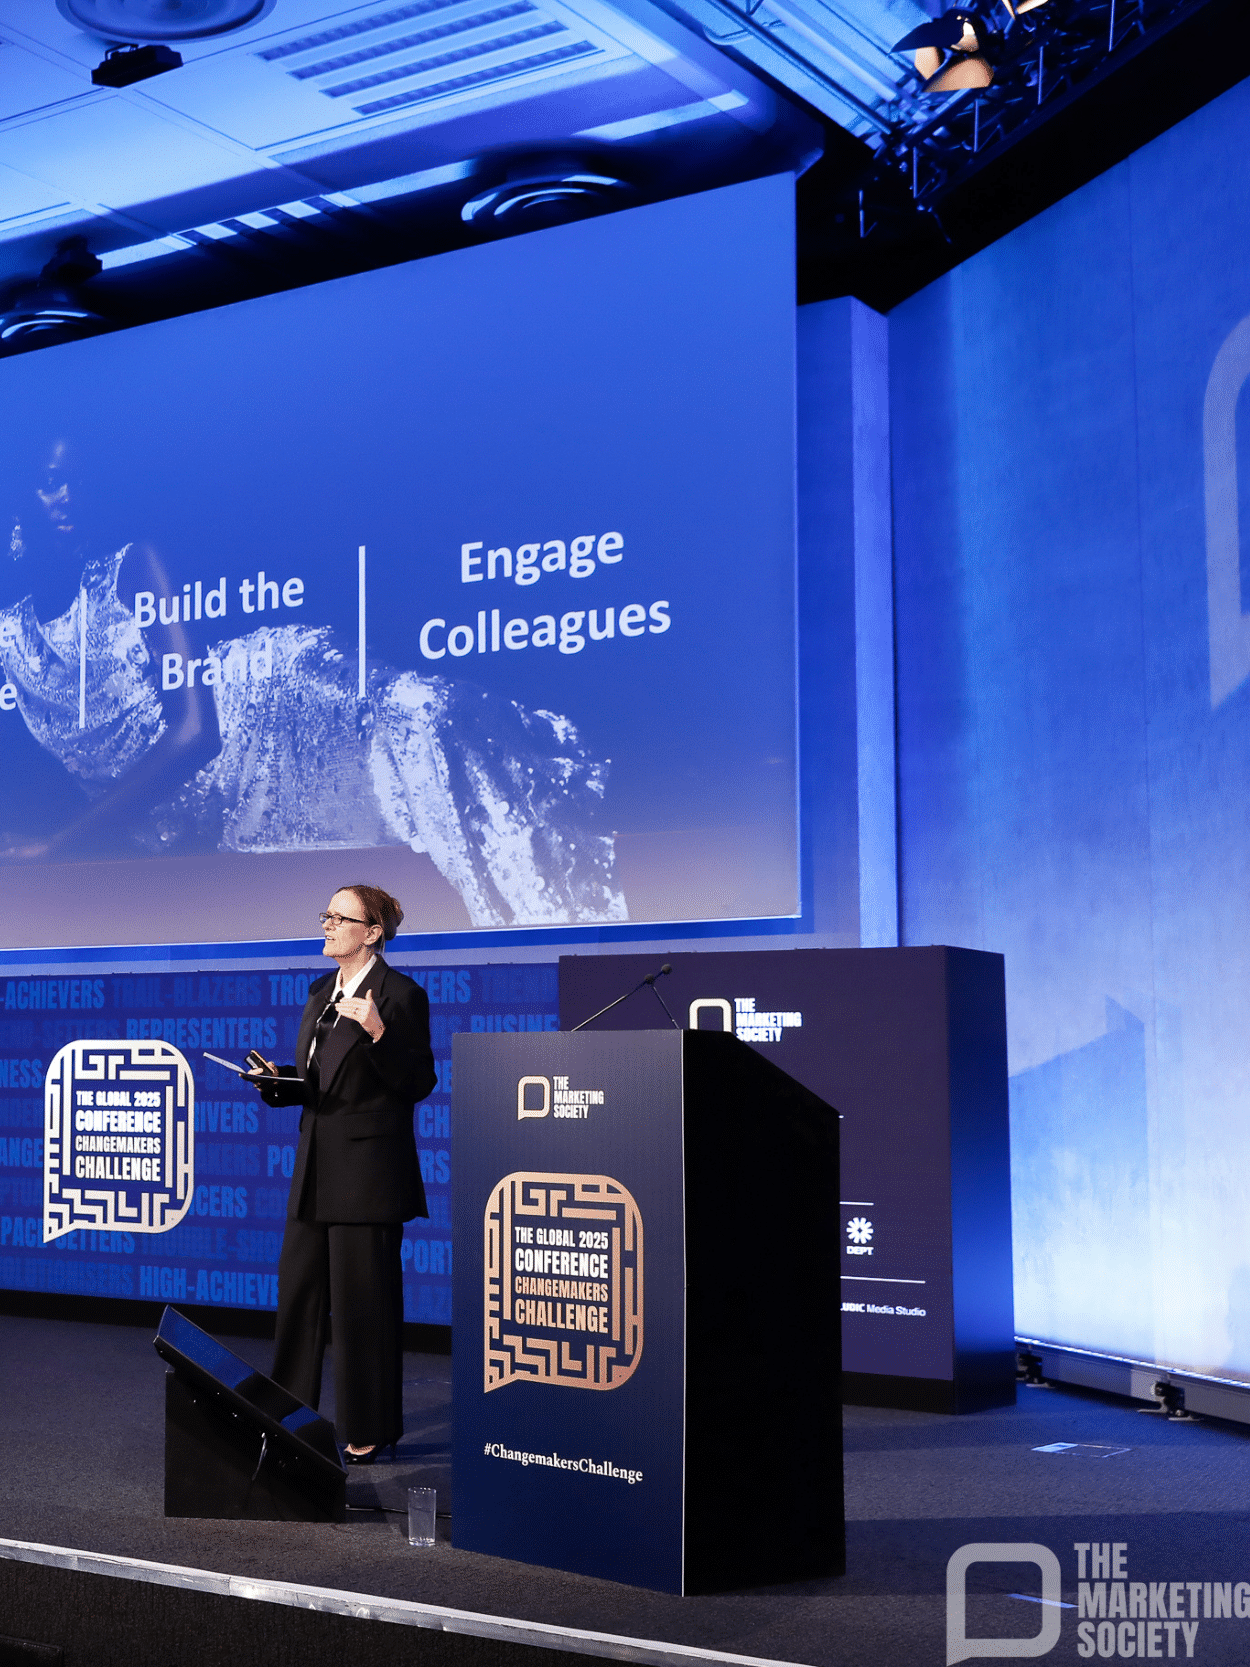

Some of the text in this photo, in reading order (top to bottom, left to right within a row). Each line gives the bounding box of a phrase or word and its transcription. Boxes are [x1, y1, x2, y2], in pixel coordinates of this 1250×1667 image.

[461, 531, 624, 586] Engage
[134, 571, 305, 628] Build the
[419, 600, 671, 660] Colleagues
[162, 638, 273, 691] Brand
[734, 998, 755, 1012] THE
[735, 1012, 802, 1027] MARKETING
[126, 1017, 277, 1049] REPRESENTERS
[736, 1027, 783, 1042] SOCIETY
[553, 1075, 569, 1090] THE
[76, 1090, 161, 1108] THE GLOBAL 2025
[553, 1090, 605, 1105] MARKETING
[75, 1109, 161, 1133] CONFERENCE
[553, 1104, 589, 1119] SOCIETY
[75, 1135, 161, 1154] CHANGEMAKERS
[75, 1155, 161, 1181] CHALLENGE
[515, 1227, 608, 1249] THE GLOBAL 2025
[846, 1246, 874, 1255] DEPT
[515, 1248, 608, 1278] CONFERENCE
[515, 1276, 608, 1302] CHANGEMAKERS
[515, 1299, 608, 1333] CHALLENGE
[866, 1304, 895, 1315] Media
[895, 1306, 926, 1317] Studio
[484, 1443, 643, 1484] #ChangemakersChallenge
